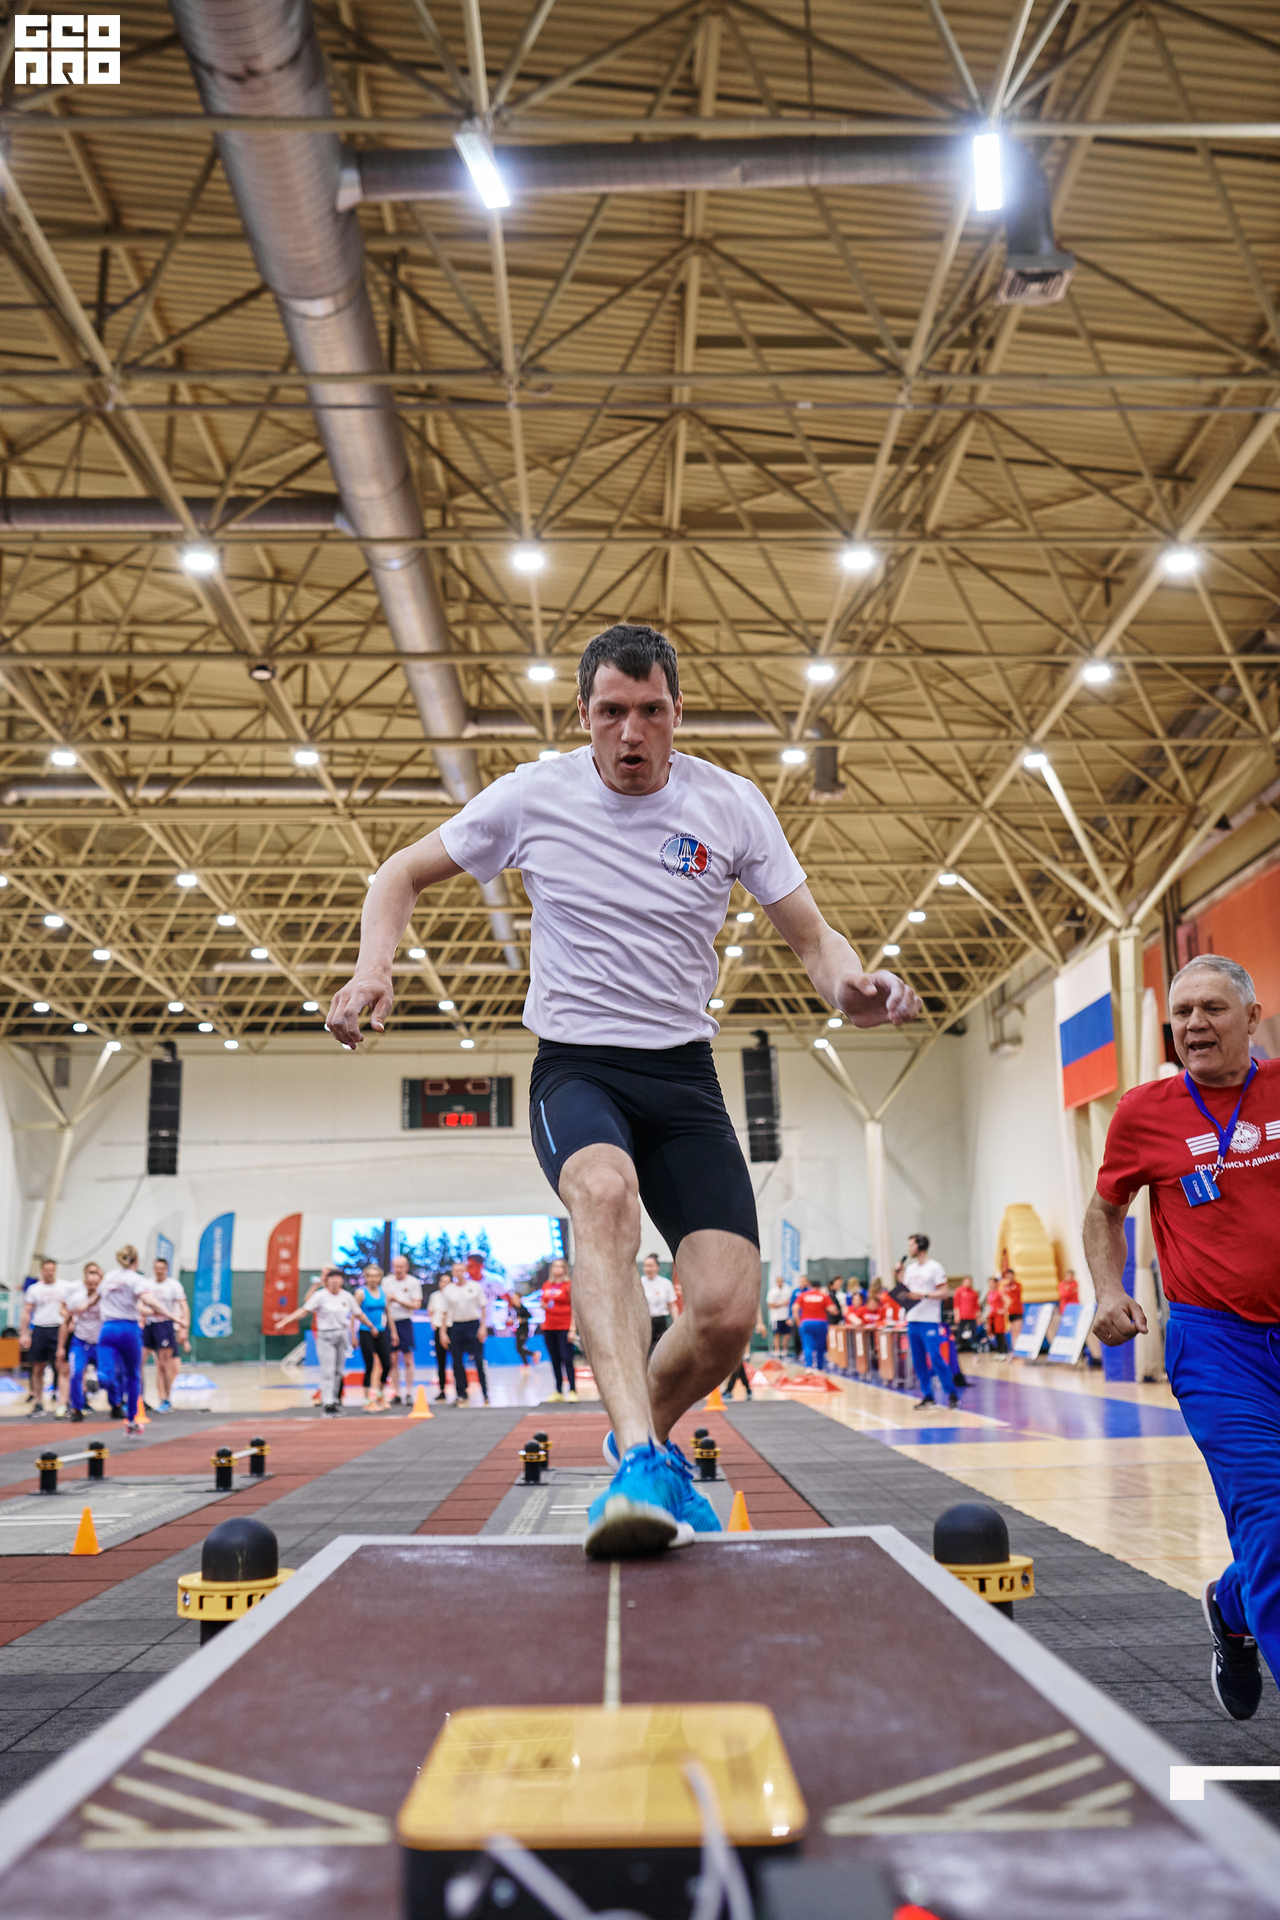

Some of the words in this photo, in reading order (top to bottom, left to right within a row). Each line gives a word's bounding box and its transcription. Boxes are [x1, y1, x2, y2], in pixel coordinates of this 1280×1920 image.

[1195, 1160, 1244, 1172] ПОДТНИСЬ
[1245, 1159, 1251, 1167] К
[956, 1576, 1014, 1593] ТО
